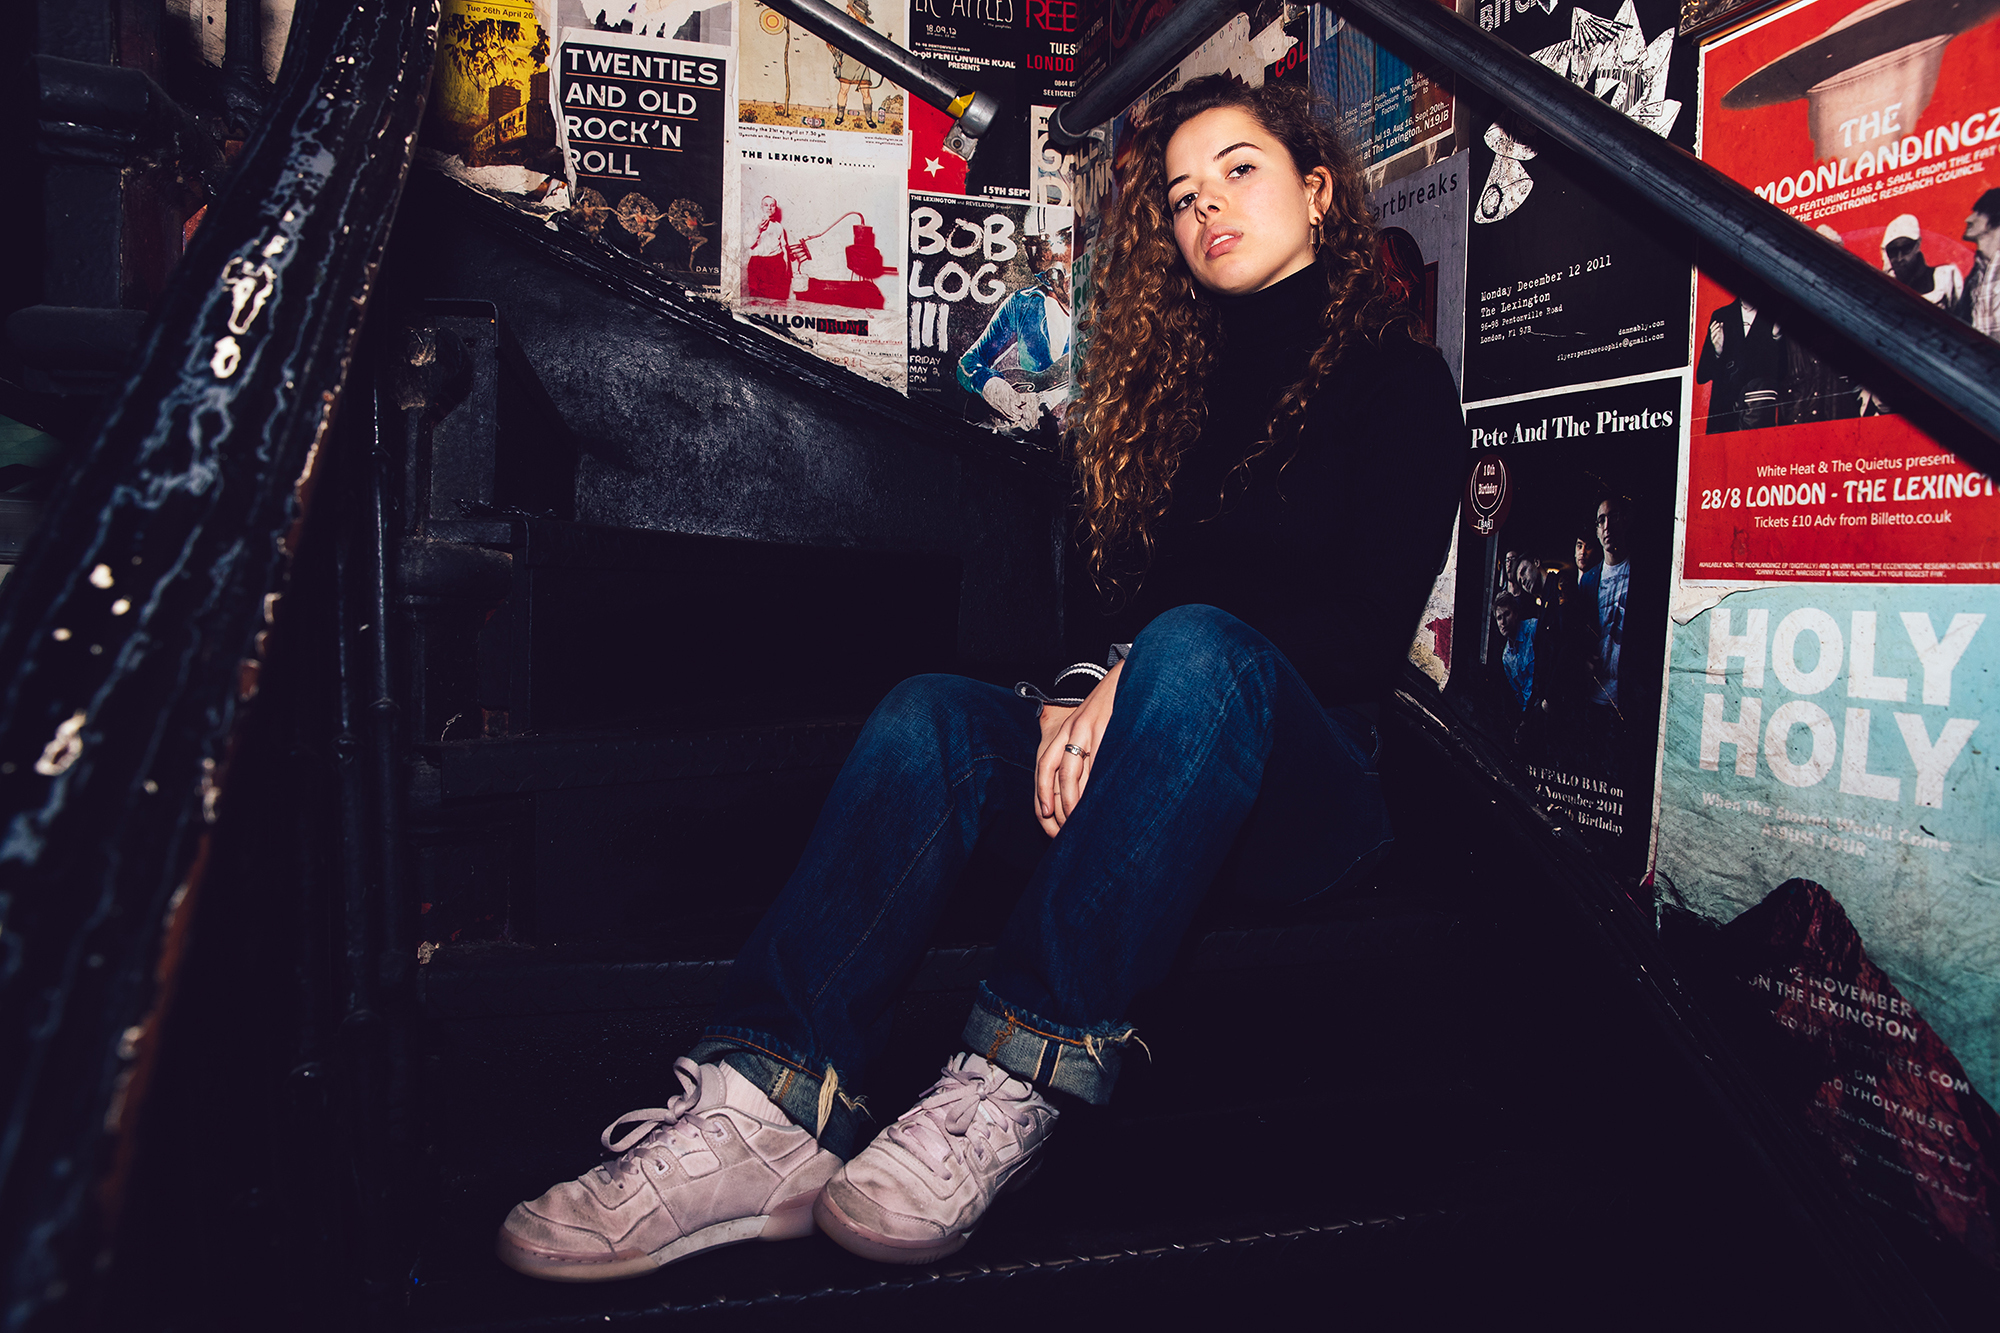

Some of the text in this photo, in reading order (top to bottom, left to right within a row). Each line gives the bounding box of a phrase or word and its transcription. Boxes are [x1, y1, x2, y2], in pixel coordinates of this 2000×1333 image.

[466, 4, 481, 12] Tue
[482, 6, 500, 15] 26th
[502, 9, 522, 18] April
[566, 48, 719, 85] TWENTIES
[948, 61, 981, 72] PRESENTS
[565, 82, 698, 116] AND OLD
[1374, 77, 1430, 112] Disclosure to Talking
[1381, 102, 1399, 116] Factory
[1404, 92, 1418, 104] Floor
[1422, 86, 1428, 94] to
[566, 115, 682, 148] ROCK'N
[1363, 150, 1371, 160] at
[1372, 142, 1385, 156] The
[1424, 110, 1450, 130] N19JB
[1392, 122, 1404, 134] Aug
[1414, 110, 1428, 123] Sept
[1838, 102, 1902, 148] THE
[568, 150, 640, 176] ROLL
[742, 150, 762, 159] THE
[768, 152, 833, 165] LEXINGTON
[1754, 105, 2000, 206] MOONLANDINGZ
[1008, 188, 1030, 198] SEPT
[1799, 145, 1996, 212] FEATURING LIAS & SAUL FROM THE FAT
[1813, 192, 1878, 220] ECCENTRONIC
[1879, 178, 1934, 200] RESEARCH
[1935, 162, 1986, 184] COUNCIL
[923, 196, 956, 205] LEXINGTON
[910, 206, 1018, 261] BOB
[696, 266, 720, 274] DAYS
[908, 260, 1006, 304] LOG
[1480, 254, 1612, 302] Monday December 12 2011
[1480, 292, 1550, 318] The Lexington
[1480, 304, 1564, 332] 96-98 Pentonville Road
[816, 318, 868, 336] DRUNK
[910, 302, 949, 352] III
[1480, 330, 1505, 344] London,
[1519, 325, 1532, 336] 9JB
[910, 354, 942, 366] FRIDAY
[910, 366, 928, 374] MAY
[1470, 408, 1673, 449] Pete And The Pirates
[1484, 464, 1496, 476] 10th
[1756, 453, 1956, 478] White Heat & The Quietus present
[1478, 482, 1498, 496] Birthday
[1700, 487, 1742, 510] 28/8
[1746, 482, 1826, 508] LONDON
[1843, 478, 1887, 504] THE
[1754, 510, 1952, 528] Tickets £10 Adv from Billetto.co.uk
[1705, 607, 1987, 706] HOLY
[1700, 692, 1980, 810] HOLY
[1545, 786, 1594, 809] November
[1596, 799, 1623, 817] 2011
[1582, 776, 1608, 794] BAR
[1610, 786, 1624, 798] on
[1578, 811, 1624, 837] Birthday
[1702, 792, 1741, 812] When
[1746, 800, 1771, 817] The
[1836, 817, 1892, 841] Would
[1821, 832, 1866, 858] TOUR
[1776, 980, 1804, 1004] THE
[1810, 992, 1918, 1044] LEXINGTON
[1858, 1117, 1898, 1140] October
[1900, 1137, 1914, 1148] on
